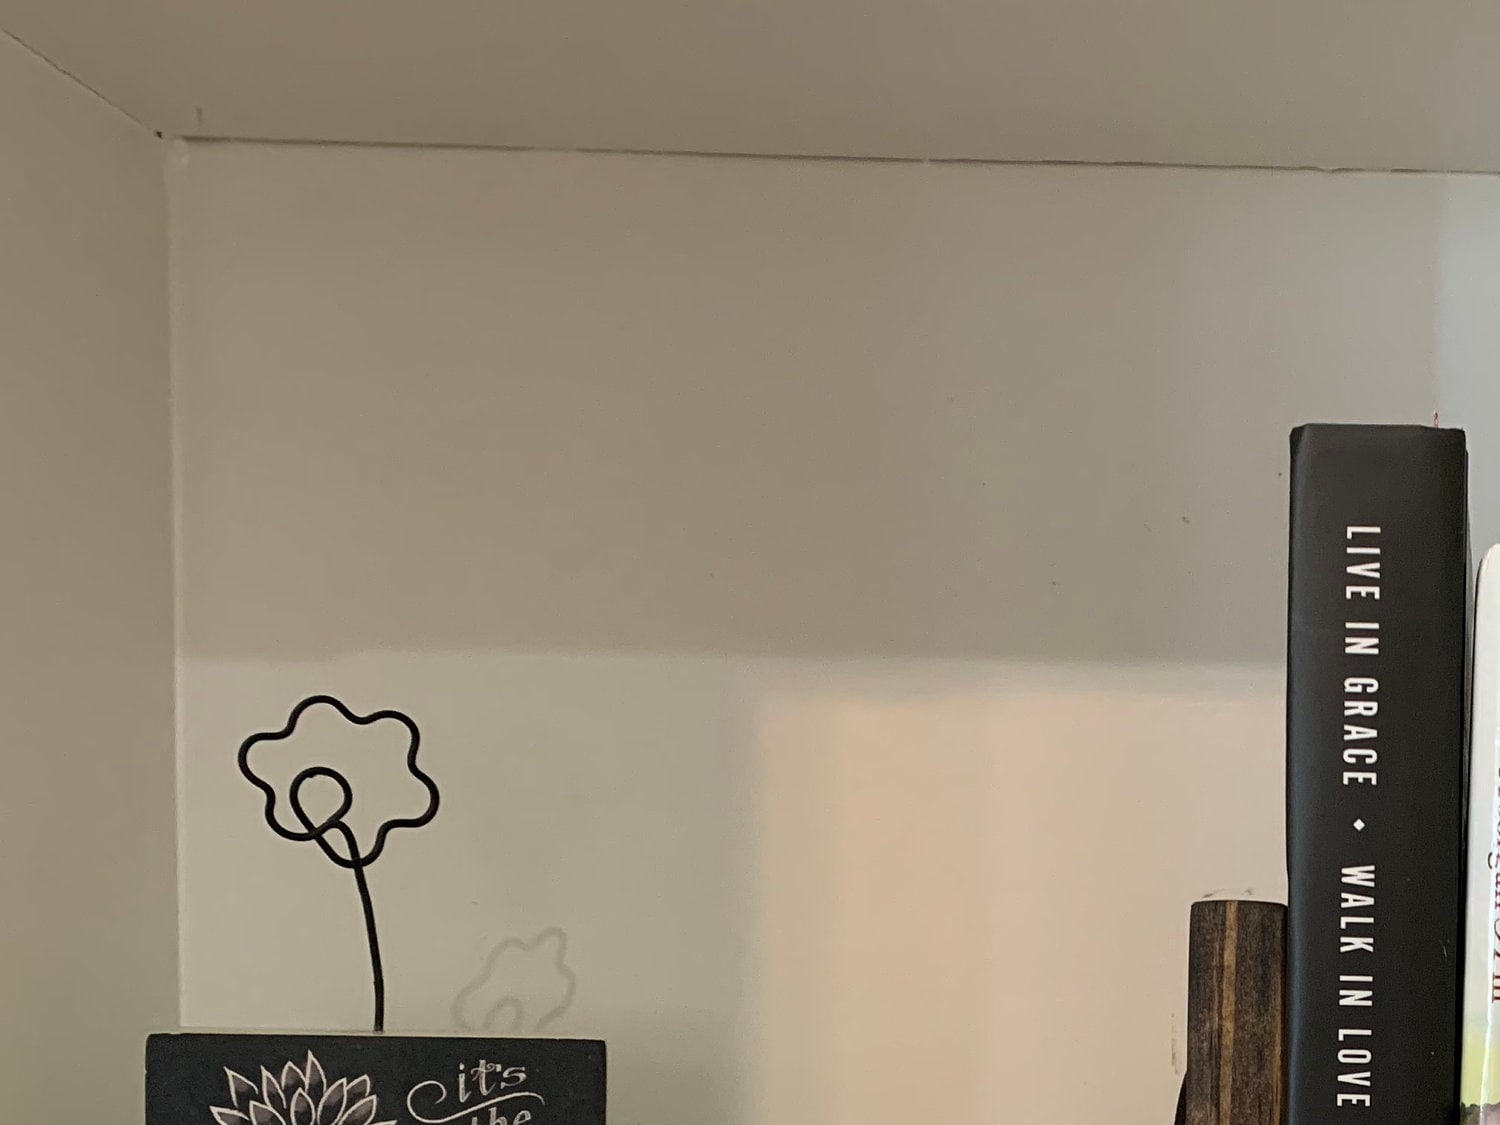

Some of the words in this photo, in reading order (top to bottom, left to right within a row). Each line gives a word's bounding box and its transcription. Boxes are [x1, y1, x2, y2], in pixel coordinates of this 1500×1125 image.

[1345, 525, 1381, 600] LIVE
[1344, 621, 1380, 655] IN
[1341, 676, 1379, 786] GRACE
[1338, 864, 1376, 954] WALK
[1338, 974, 1374, 1007] IN
[456, 1059, 528, 1104] it's
[1336, 1028, 1373, 1108] LOVE
